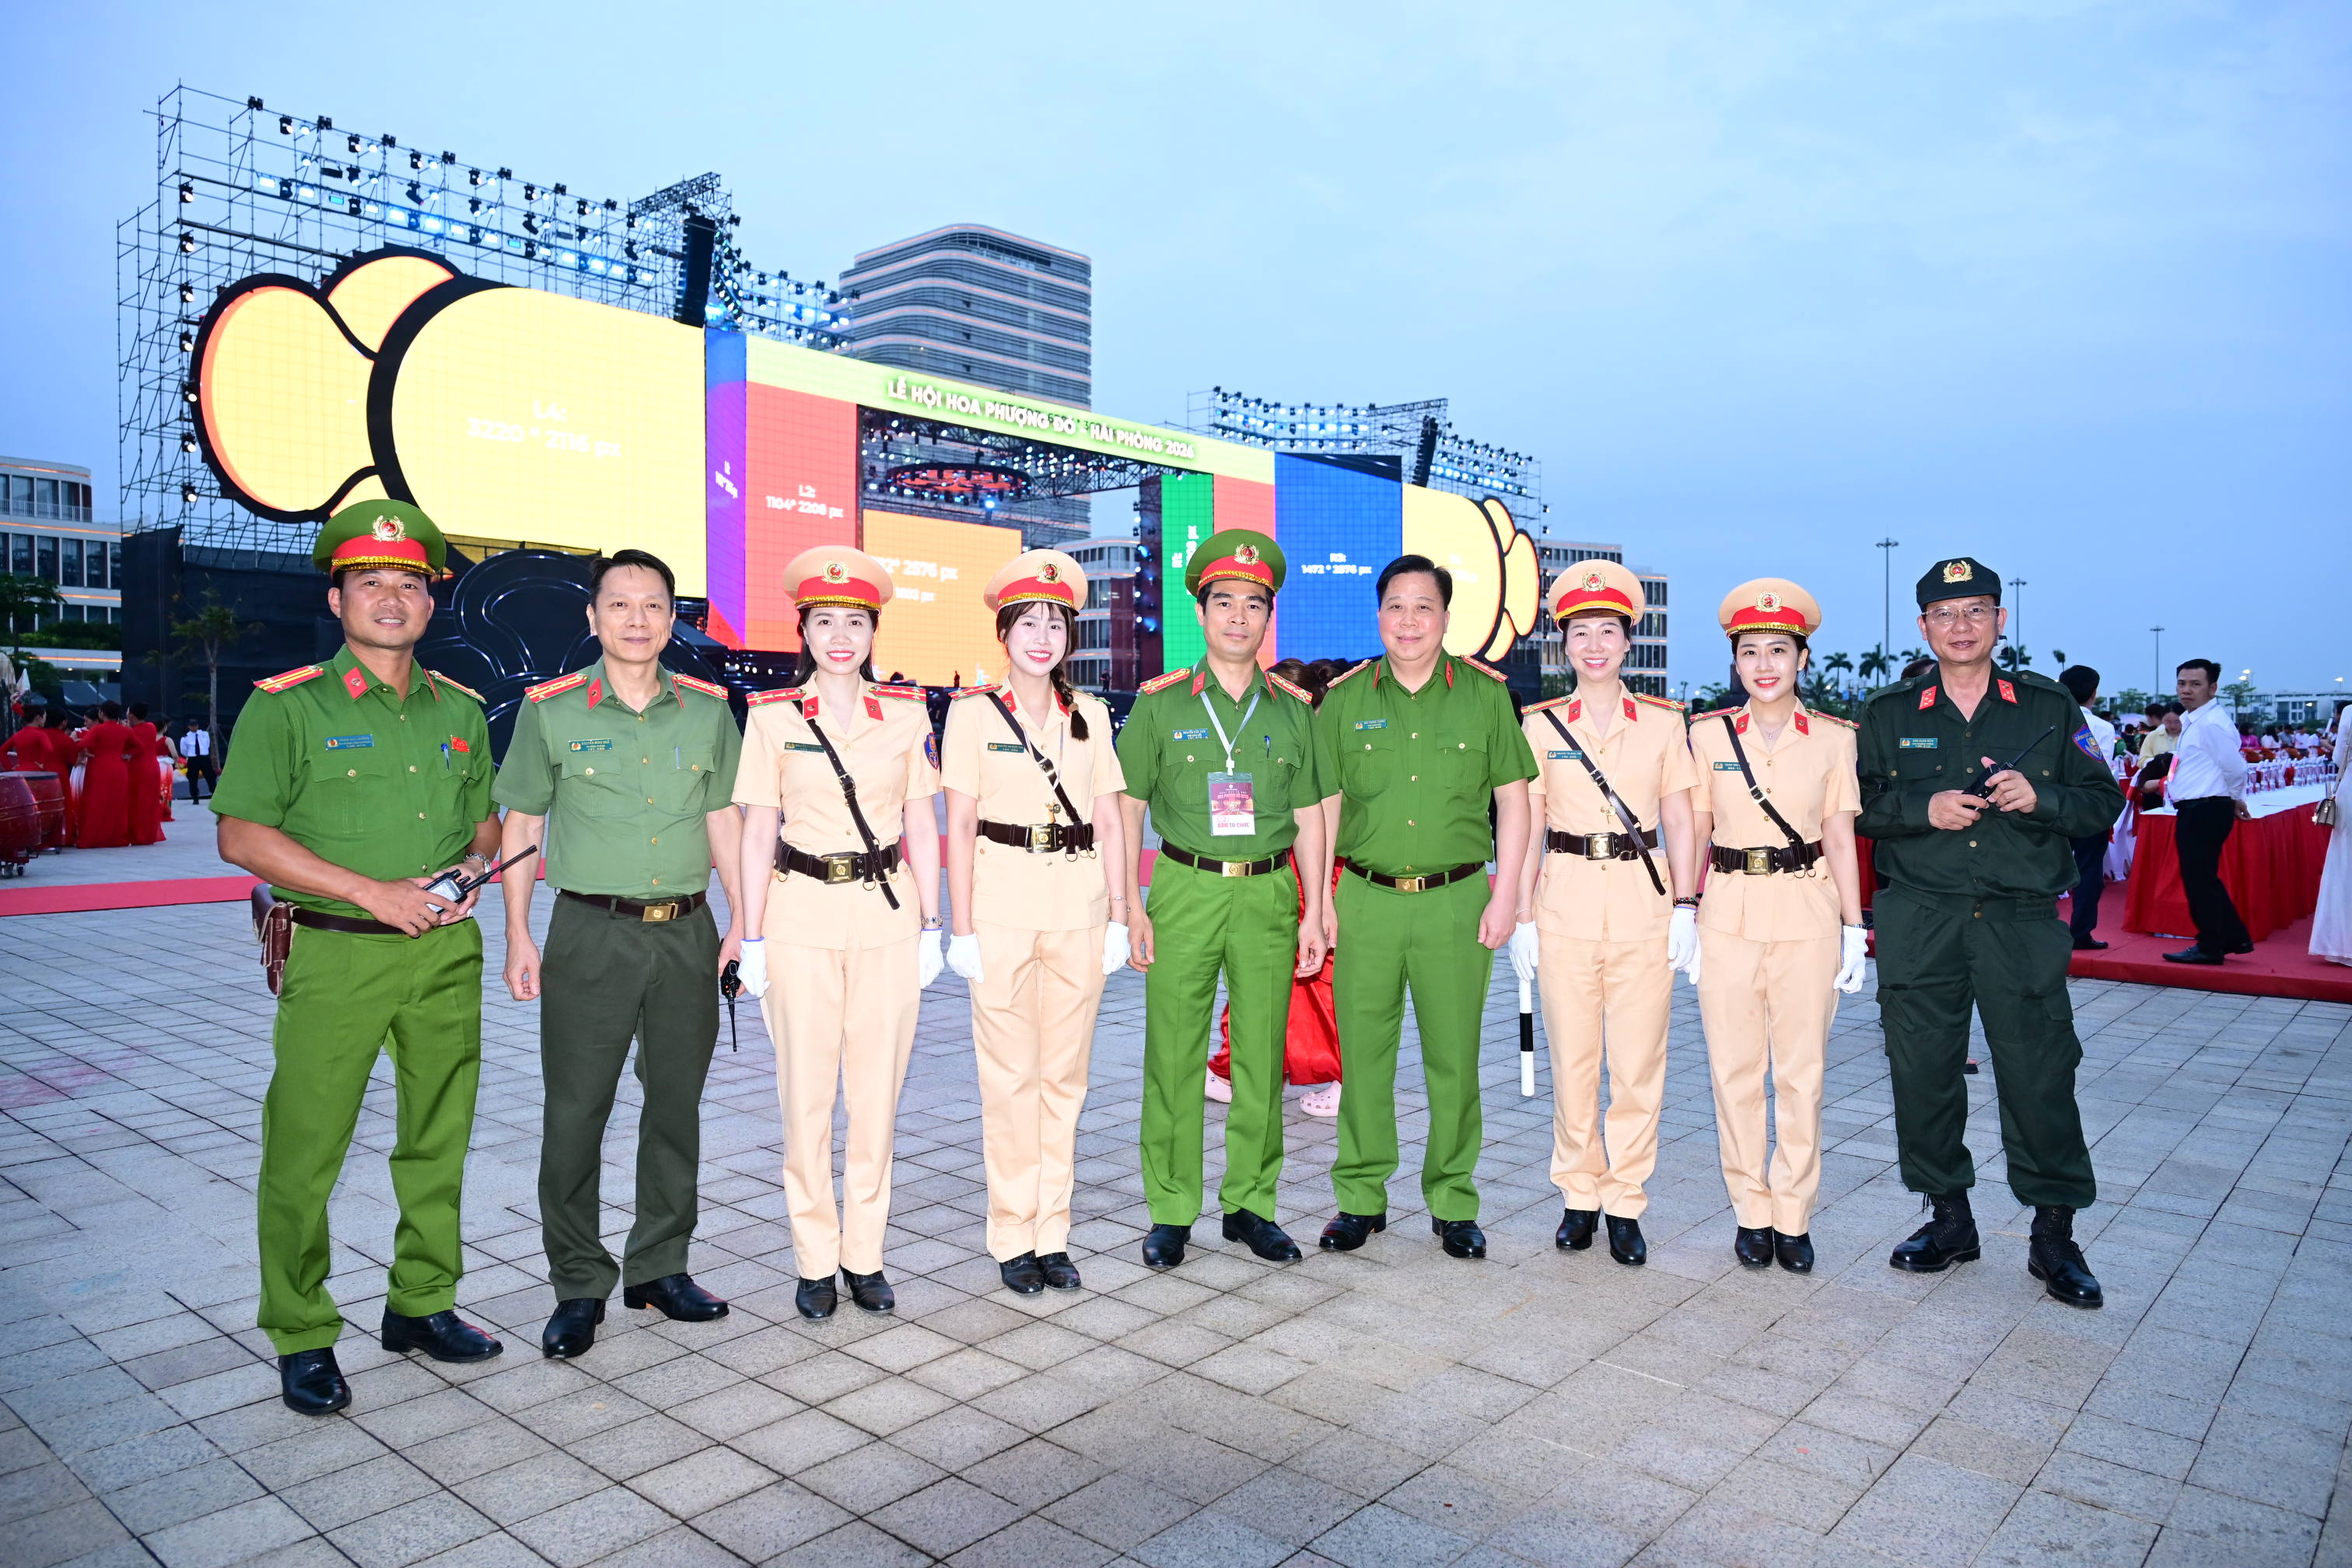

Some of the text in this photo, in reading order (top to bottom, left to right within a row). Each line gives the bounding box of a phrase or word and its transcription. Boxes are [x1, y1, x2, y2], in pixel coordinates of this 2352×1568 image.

[911, 384, 942, 410] HỘI
[946, 393, 982, 416] HOA
[985, 401, 1050, 429] PHƯỢNG
[1090, 422, 1113, 443] HẢI
[1116, 429, 1163, 453] PHÒNG
[1165, 439, 1195, 459] 2026
[594, 440, 621, 458] px
